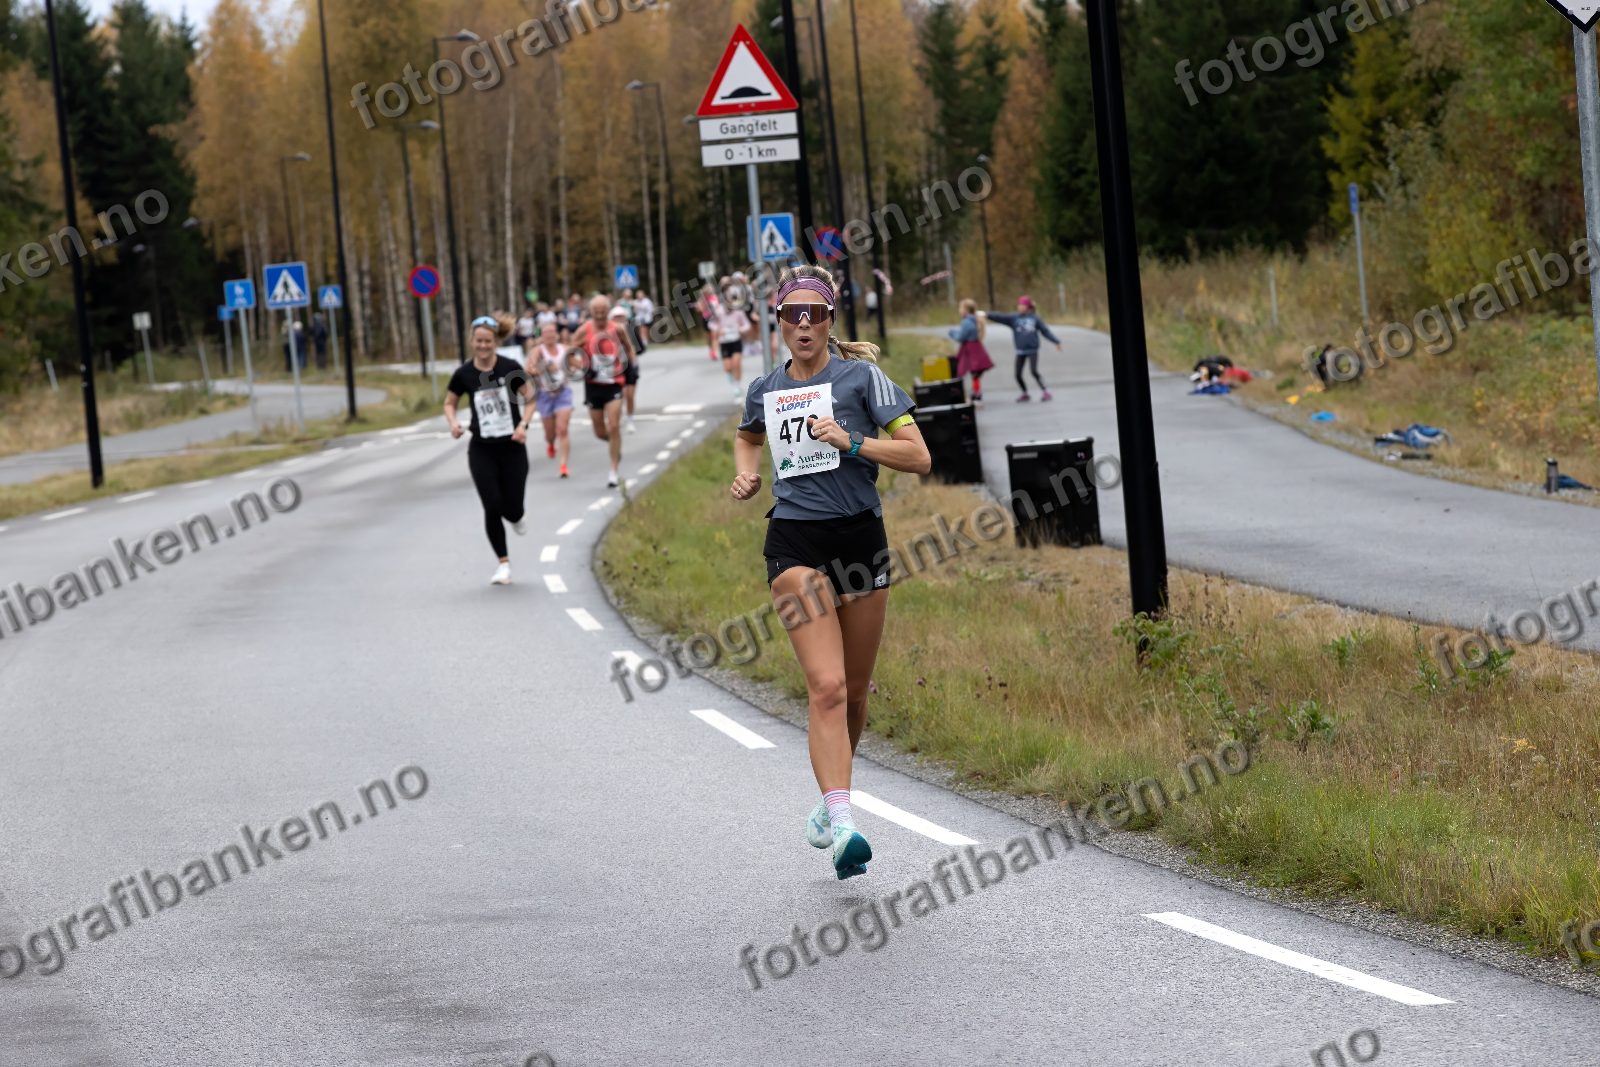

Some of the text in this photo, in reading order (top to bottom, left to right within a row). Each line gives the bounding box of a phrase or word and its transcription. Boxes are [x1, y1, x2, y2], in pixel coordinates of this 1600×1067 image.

[719, 119, 778, 136] Gangfelt
[724, 148, 734, 160] 0
[748, 146, 753, 158] 1
[757, 146, 777, 157] km
[777, 391, 820, 404] NORGES
[781, 400, 812, 412] LØPET
[797, 451, 837, 464] Aurskog
